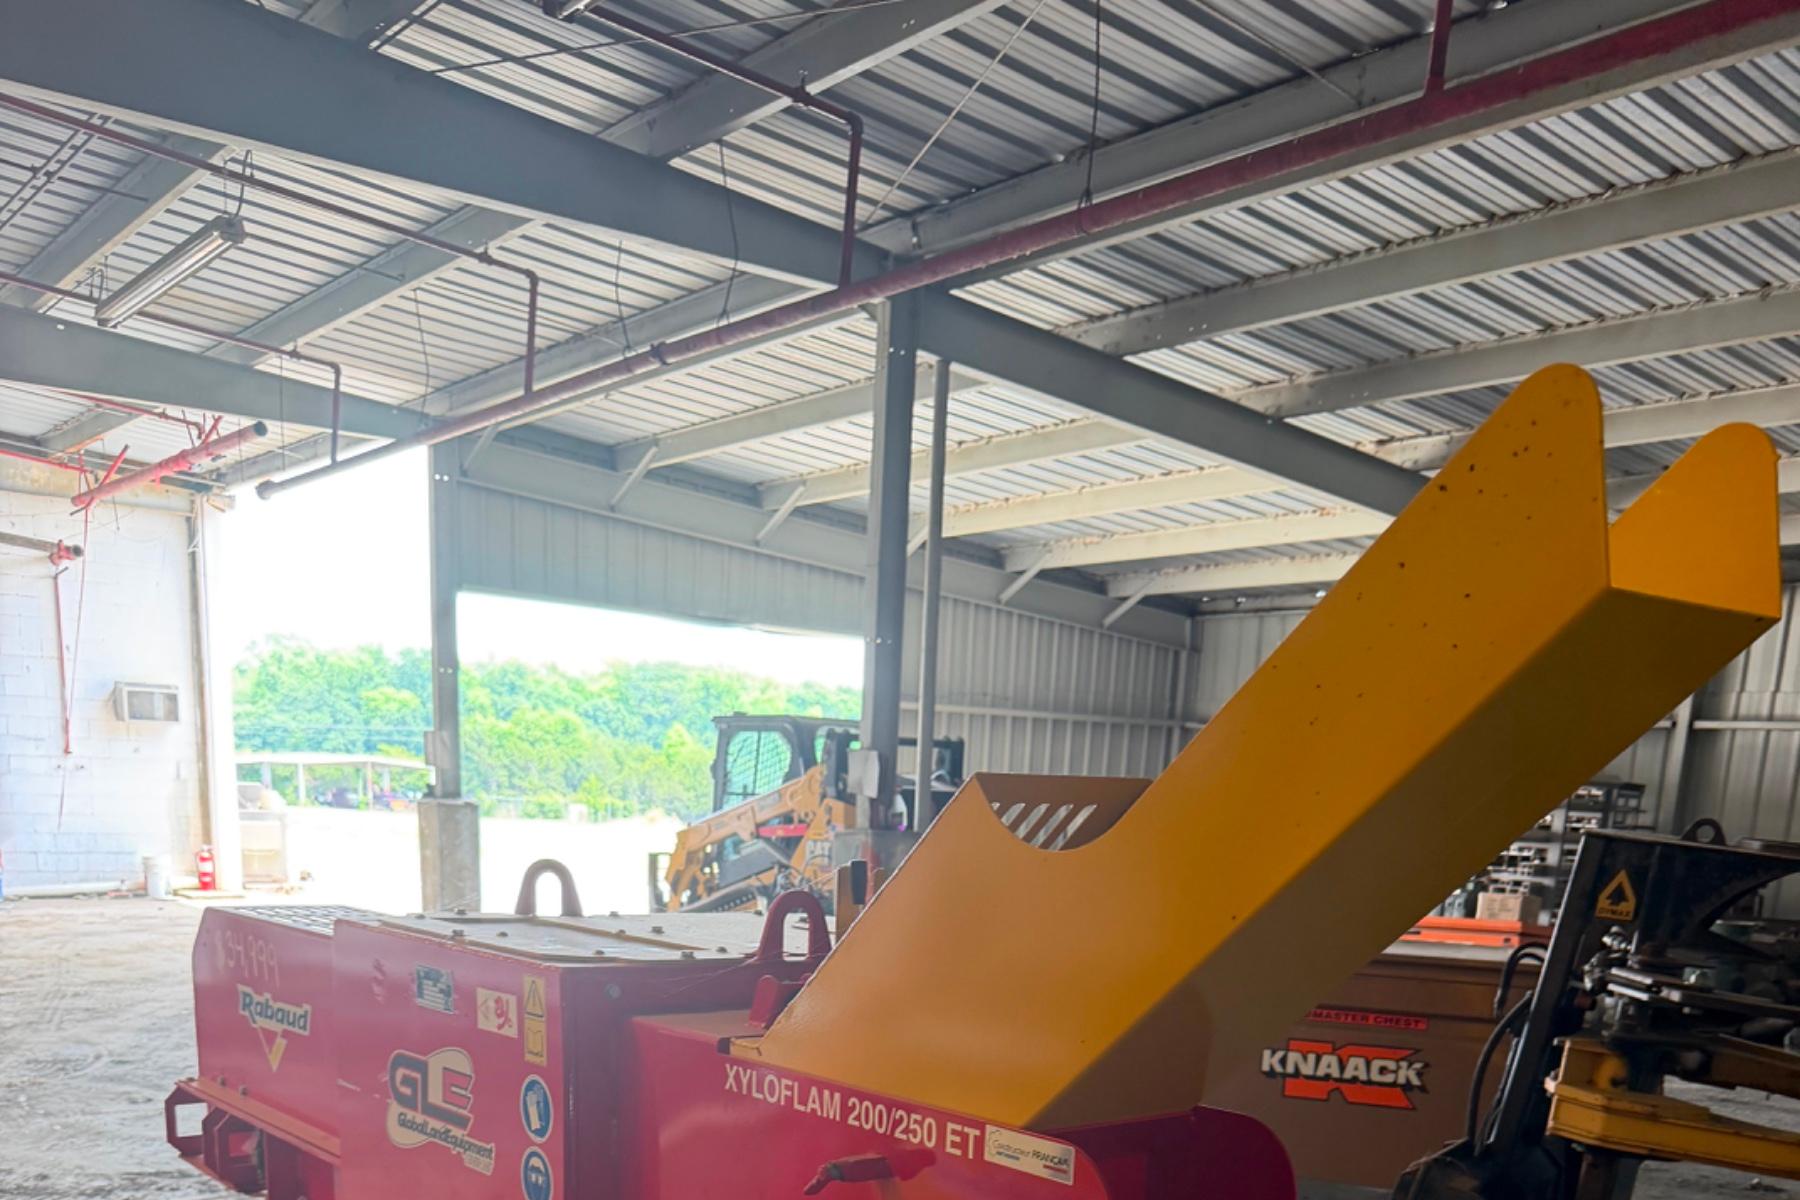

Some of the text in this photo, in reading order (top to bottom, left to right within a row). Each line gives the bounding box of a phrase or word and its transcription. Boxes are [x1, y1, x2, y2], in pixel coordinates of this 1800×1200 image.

[241, 991, 309, 1032] Rabaud
[1311, 1009, 1422, 1028] MASTER CHEST
[1260, 1049, 1427, 1087] KNAACK
[724, 1063, 981, 1160] XYLOFLAM 200/250 ET
